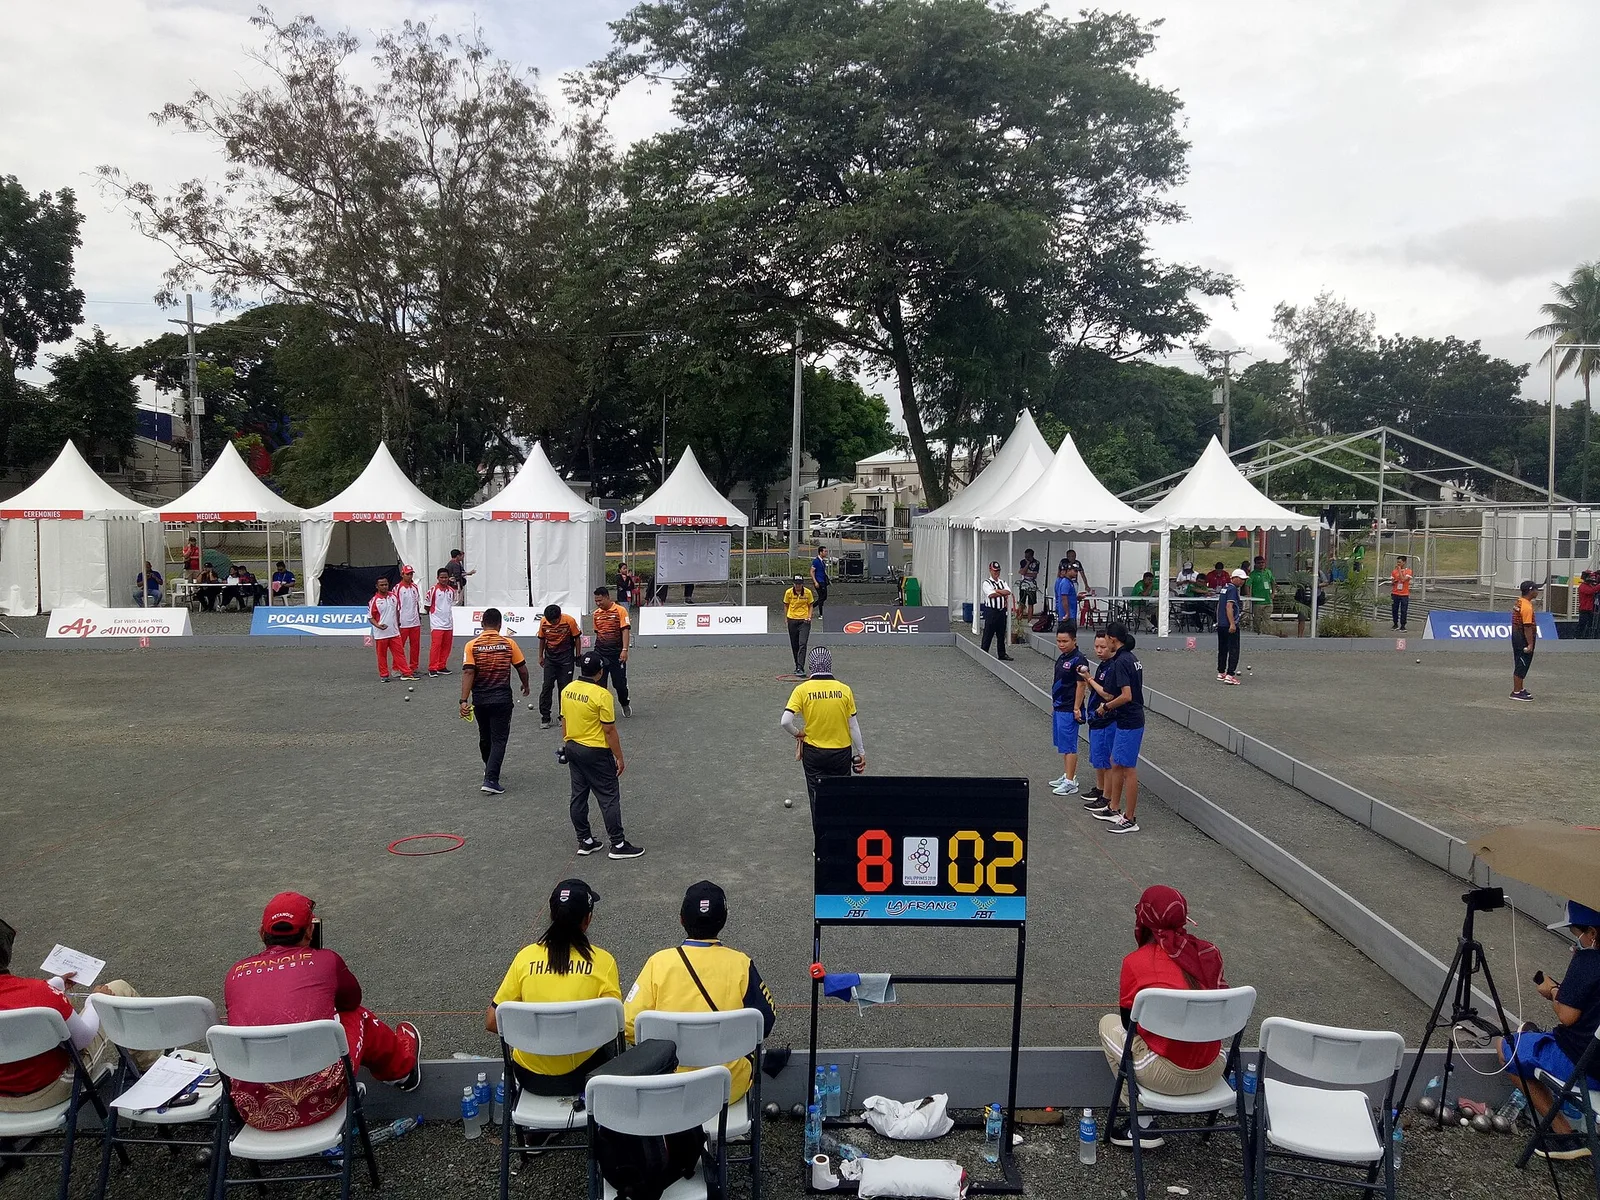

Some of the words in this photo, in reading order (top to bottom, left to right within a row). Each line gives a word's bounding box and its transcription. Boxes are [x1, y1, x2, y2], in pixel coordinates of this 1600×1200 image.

[24, 511, 61, 519] CEREMONIES
[196, 512, 221, 521] MEDICAL
[352, 512, 371, 521] SOUND
[373, 512, 385, 521] AND
[510, 511, 529, 520] SOUND
[531, 511, 543, 520] AND
[268, 614, 318, 624] POCARI
[322, 614, 369, 624] SWEAT
[101, 625, 170, 636] AJINOMOTO
[865, 624, 919, 634] PULSE
[1449, 624, 1543, 639] SKYWO
[808, 690, 843, 701] THAILAND
[857, 830, 892, 892] 8
[948, 830, 1023, 893] 02
[232, 960, 315, 981] INDONESIA
